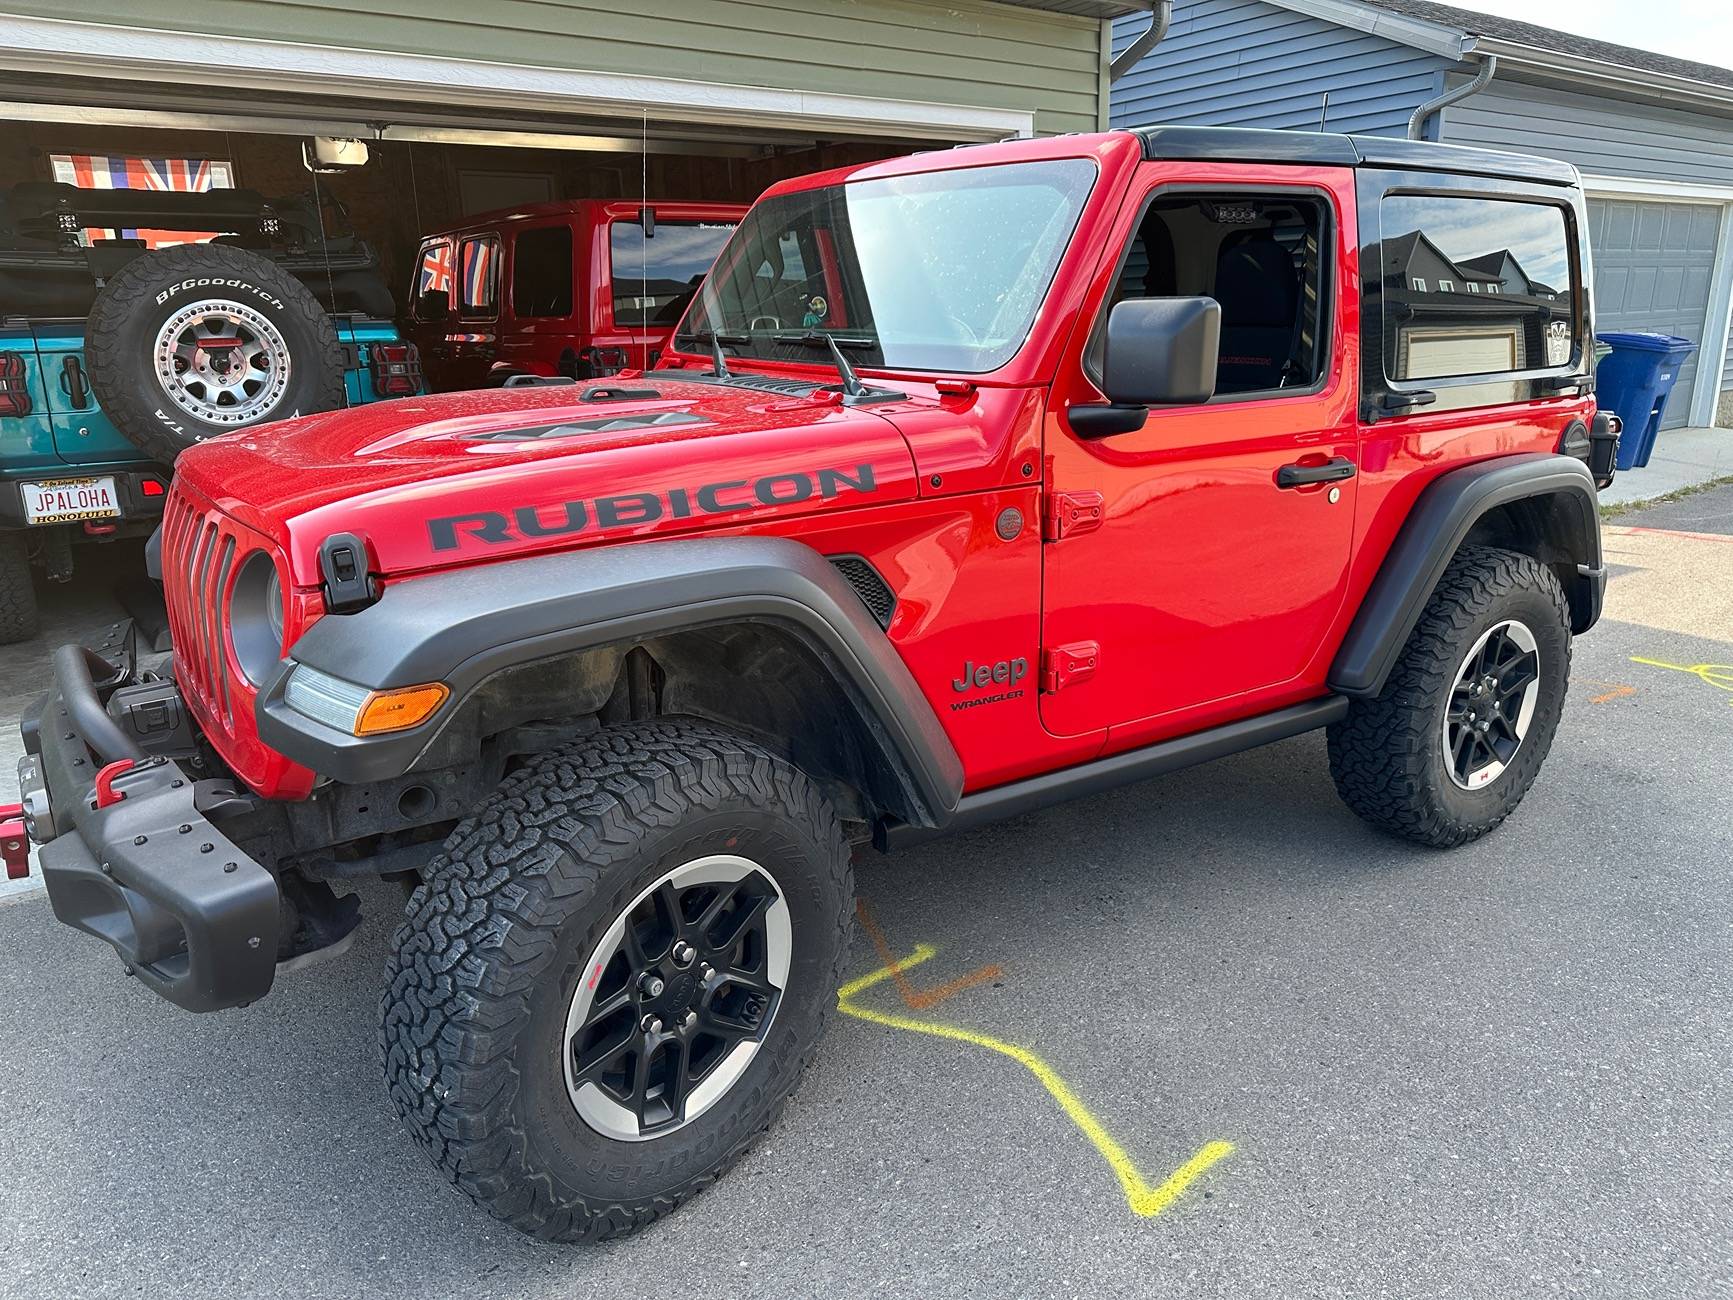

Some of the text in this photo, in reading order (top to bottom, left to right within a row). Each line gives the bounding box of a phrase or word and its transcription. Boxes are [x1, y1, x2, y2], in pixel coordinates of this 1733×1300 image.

[155, 278, 284, 310] BFGoodrich
[35, 488, 111, 512] JPALOHA
[426, 462, 877, 552] RUBICON
[36, 510, 112, 522] HONOLULU
[952, 656, 1028, 692] Jeep
[950, 689, 1024, 711] WRANGLER
